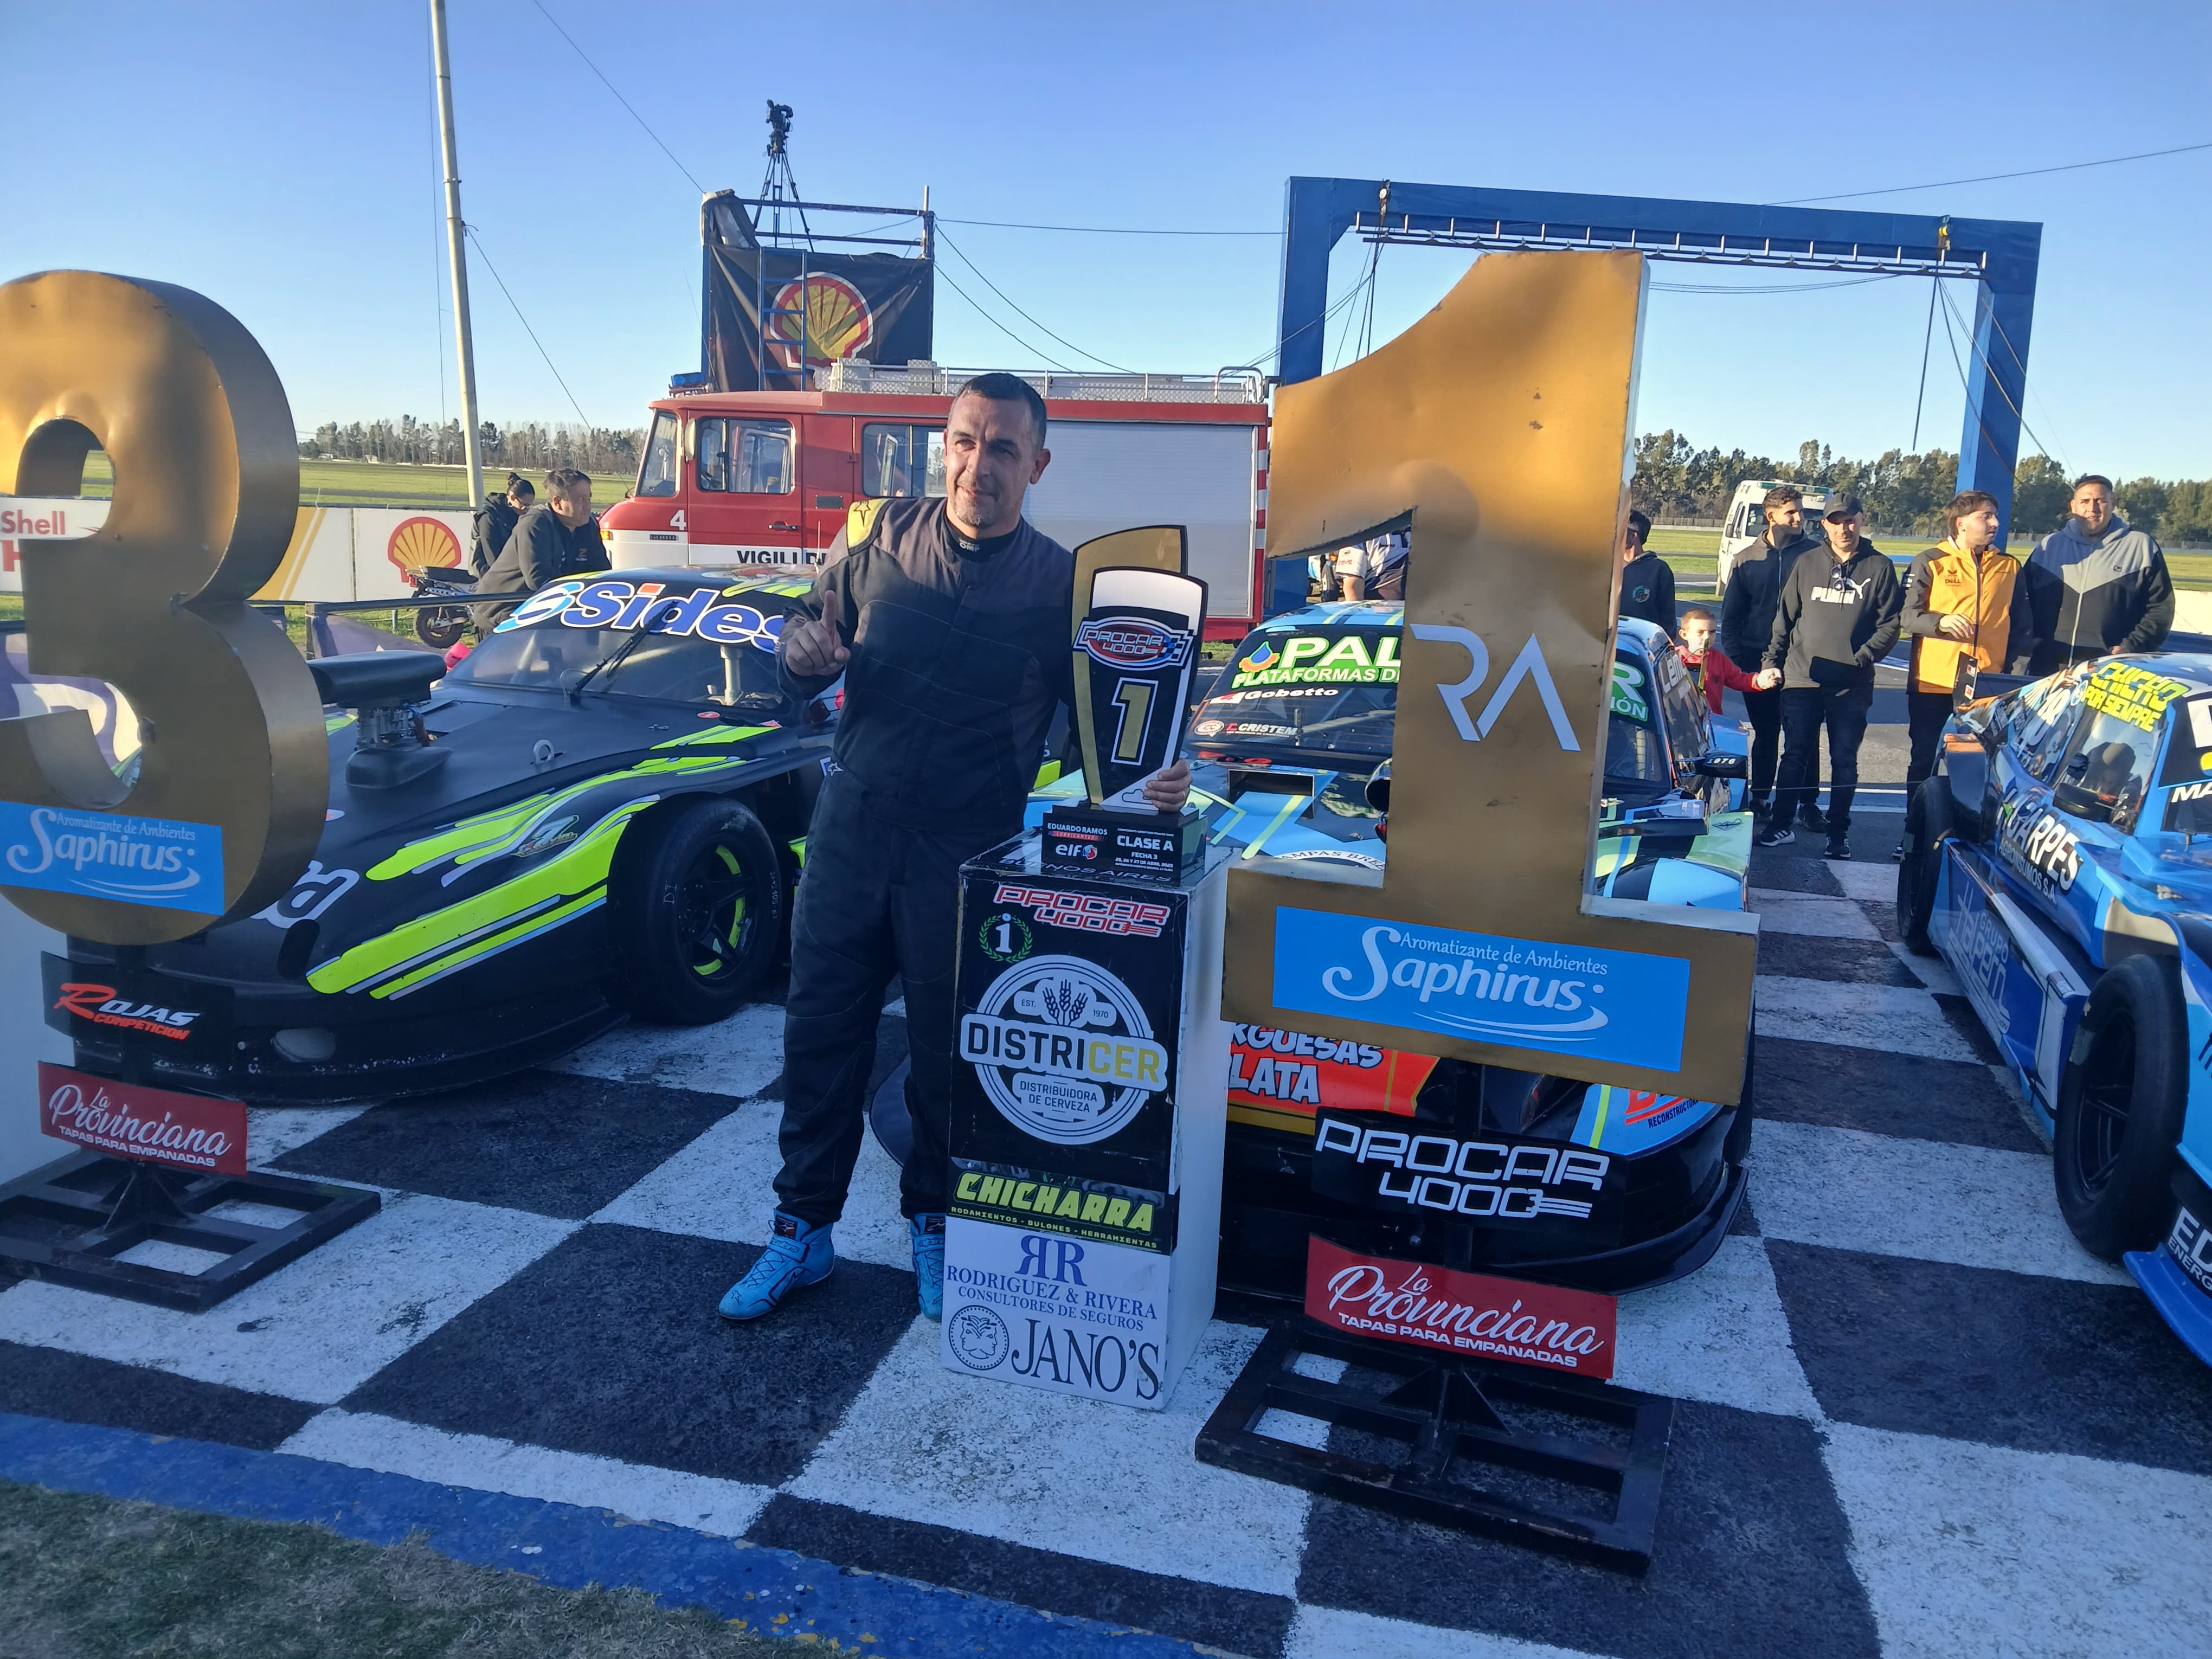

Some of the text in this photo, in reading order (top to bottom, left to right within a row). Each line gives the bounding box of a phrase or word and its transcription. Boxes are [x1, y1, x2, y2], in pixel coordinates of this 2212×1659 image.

[1, 509, 66, 535] Shell
[670, 509, 687, 531] 4
[959, 541, 980, 552] OMP
[1811, 586, 1855, 604] PUMA
[1084, 630, 1164, 646] PROCAR
[1102, 642, 1159, 655] 4000
[1232, 667, 1377, 689] PLATAFORMAS
[1244, 687, 1339, 700] Gobetto
[1410, 624, 1581, 751] RA
[1111, 677, 1159, 766] 1
[2081, 685, 2104, 710] POR
[2102, 695, 2162, 732] SIEMPRE
[1238, 723, 1298, 736] CRISTEM
[6, 808, 184, 874] Saphirus
[56, 812, 196, 842] Aromatizante de Ambientes
[1047, 822, 1082, 833] EDUARDO
[1082, 826, 1108, 835] RAMOS
[1117, 835, 1174, 852] CLASE A
[998, 858, 1173, 883] BUENOS AIRES
[1055, 843, 1083, 858] elf
[994, 885, 1171, 926] PROCAR
[1034, 910, 1162, 938] 4000
[1400, 931, 1608, 976] Aromatizante de Ambientes
[1980, 912, 2009, 963] GRUPO
[1321, 925, 1587, 1012] Saphirus
[54, 982, 201, 1027] ROJAS
[1021, 998, 1109, 1019] EST. 1970
[93, 1013, 190, 1040] COMPETICION
[967, 1021, 1161, 1084] DISTRICER
[90, 1087, 111, 1109] La
[1019, 1080, 1098, 1102] DISTRIBUIDORA
[1229, 1053, 1321, 1104] LATA
[48, 1084, 233, 1157] Provinciana
[1028, 1095, 1090, 1114] DE CERVEZA
[59, 1125, 216, 1168] TAPAS PARA EMPANADAS
[1315, 1118, 1610, 1191] PROCAR
[955, 1172, 1155, 1233] CHICHARRA
[1379, 1172, 1593, 1219] 4000
[951, 1206, 1018, 1223] RODAMIENTOS
[1027, 1219, 1071, 1233] BULONES
[1081, 1229, 1157, 1249] HERRAMIENTAS
[946, 1265, 1158, 1320] RODRIGUEZ & RIVERA
[1398, 1265, 1432, 1296] La
[959, 1287, 1144, 1331] CONSULTORES DE SEGUROS
[1327, 1264, 1605, 1355] Provinciana
[1012, 1319, 1160, 1400] JANO'S
[1339, 1312, 1578, 1368] TAPAS PARA EMPANADAS
